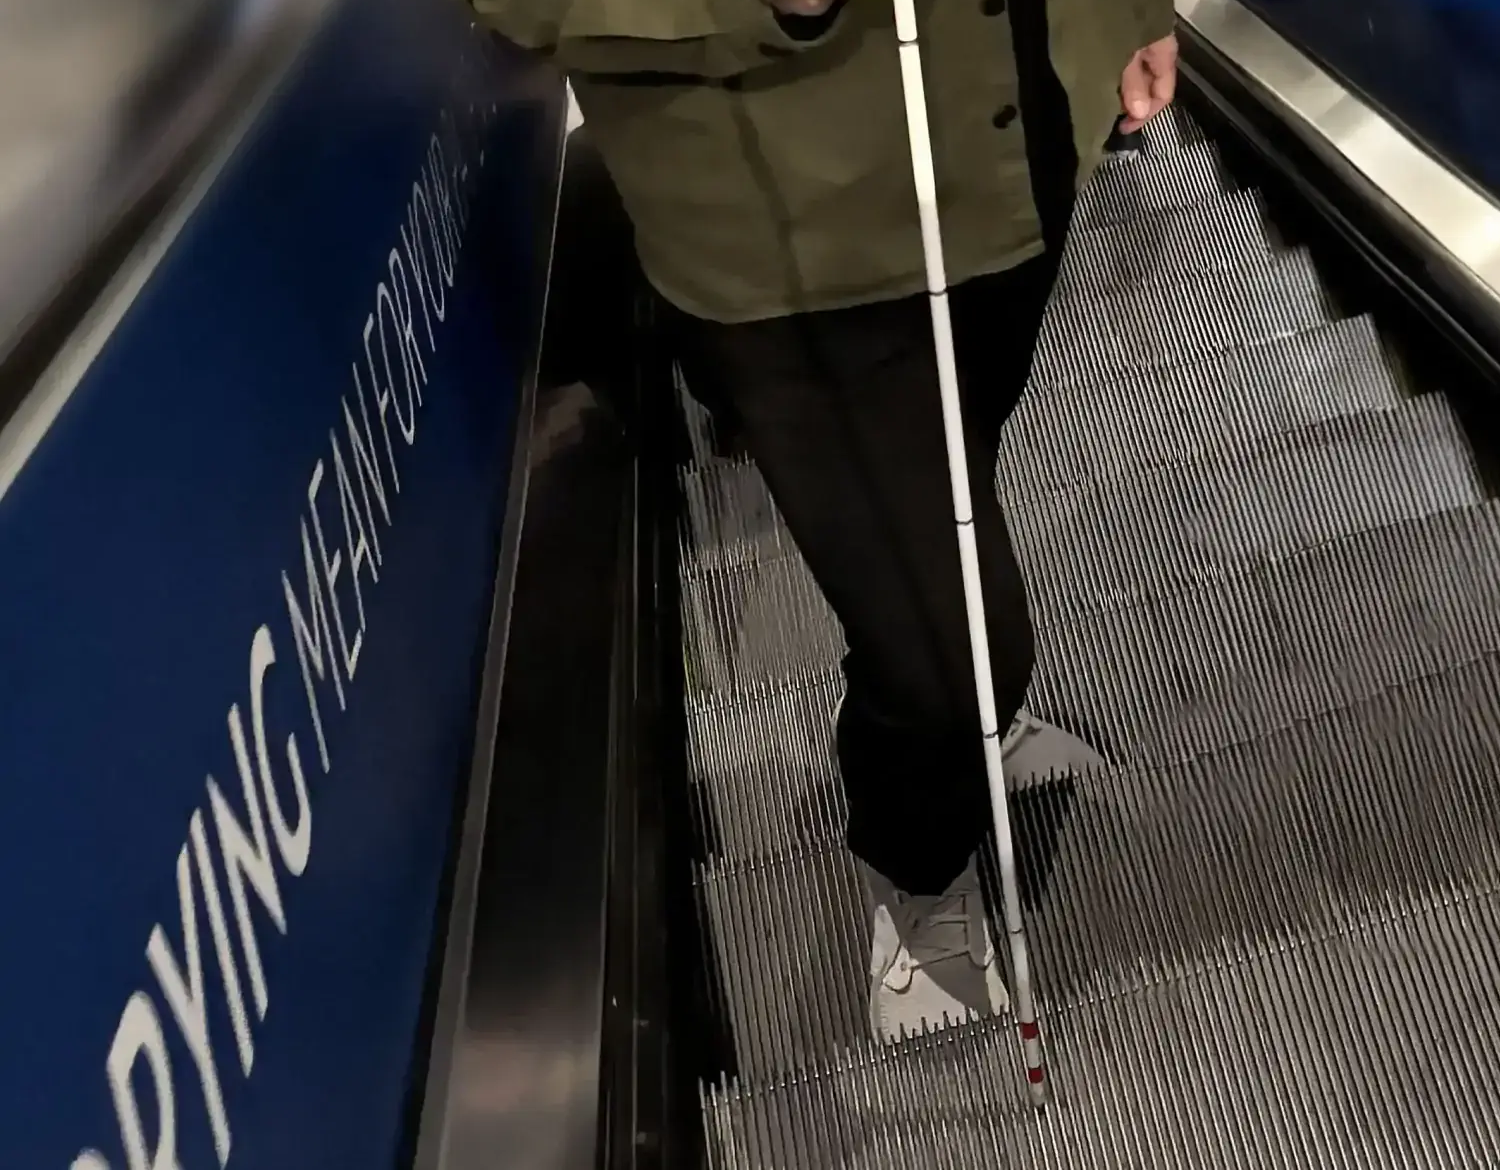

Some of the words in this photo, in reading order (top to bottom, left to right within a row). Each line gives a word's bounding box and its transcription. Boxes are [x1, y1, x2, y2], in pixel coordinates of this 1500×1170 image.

[68, 623, 313, 1170] RYING
[280, 361, 393, 775] MEAN
[361, 246, 429, 495] FOR
